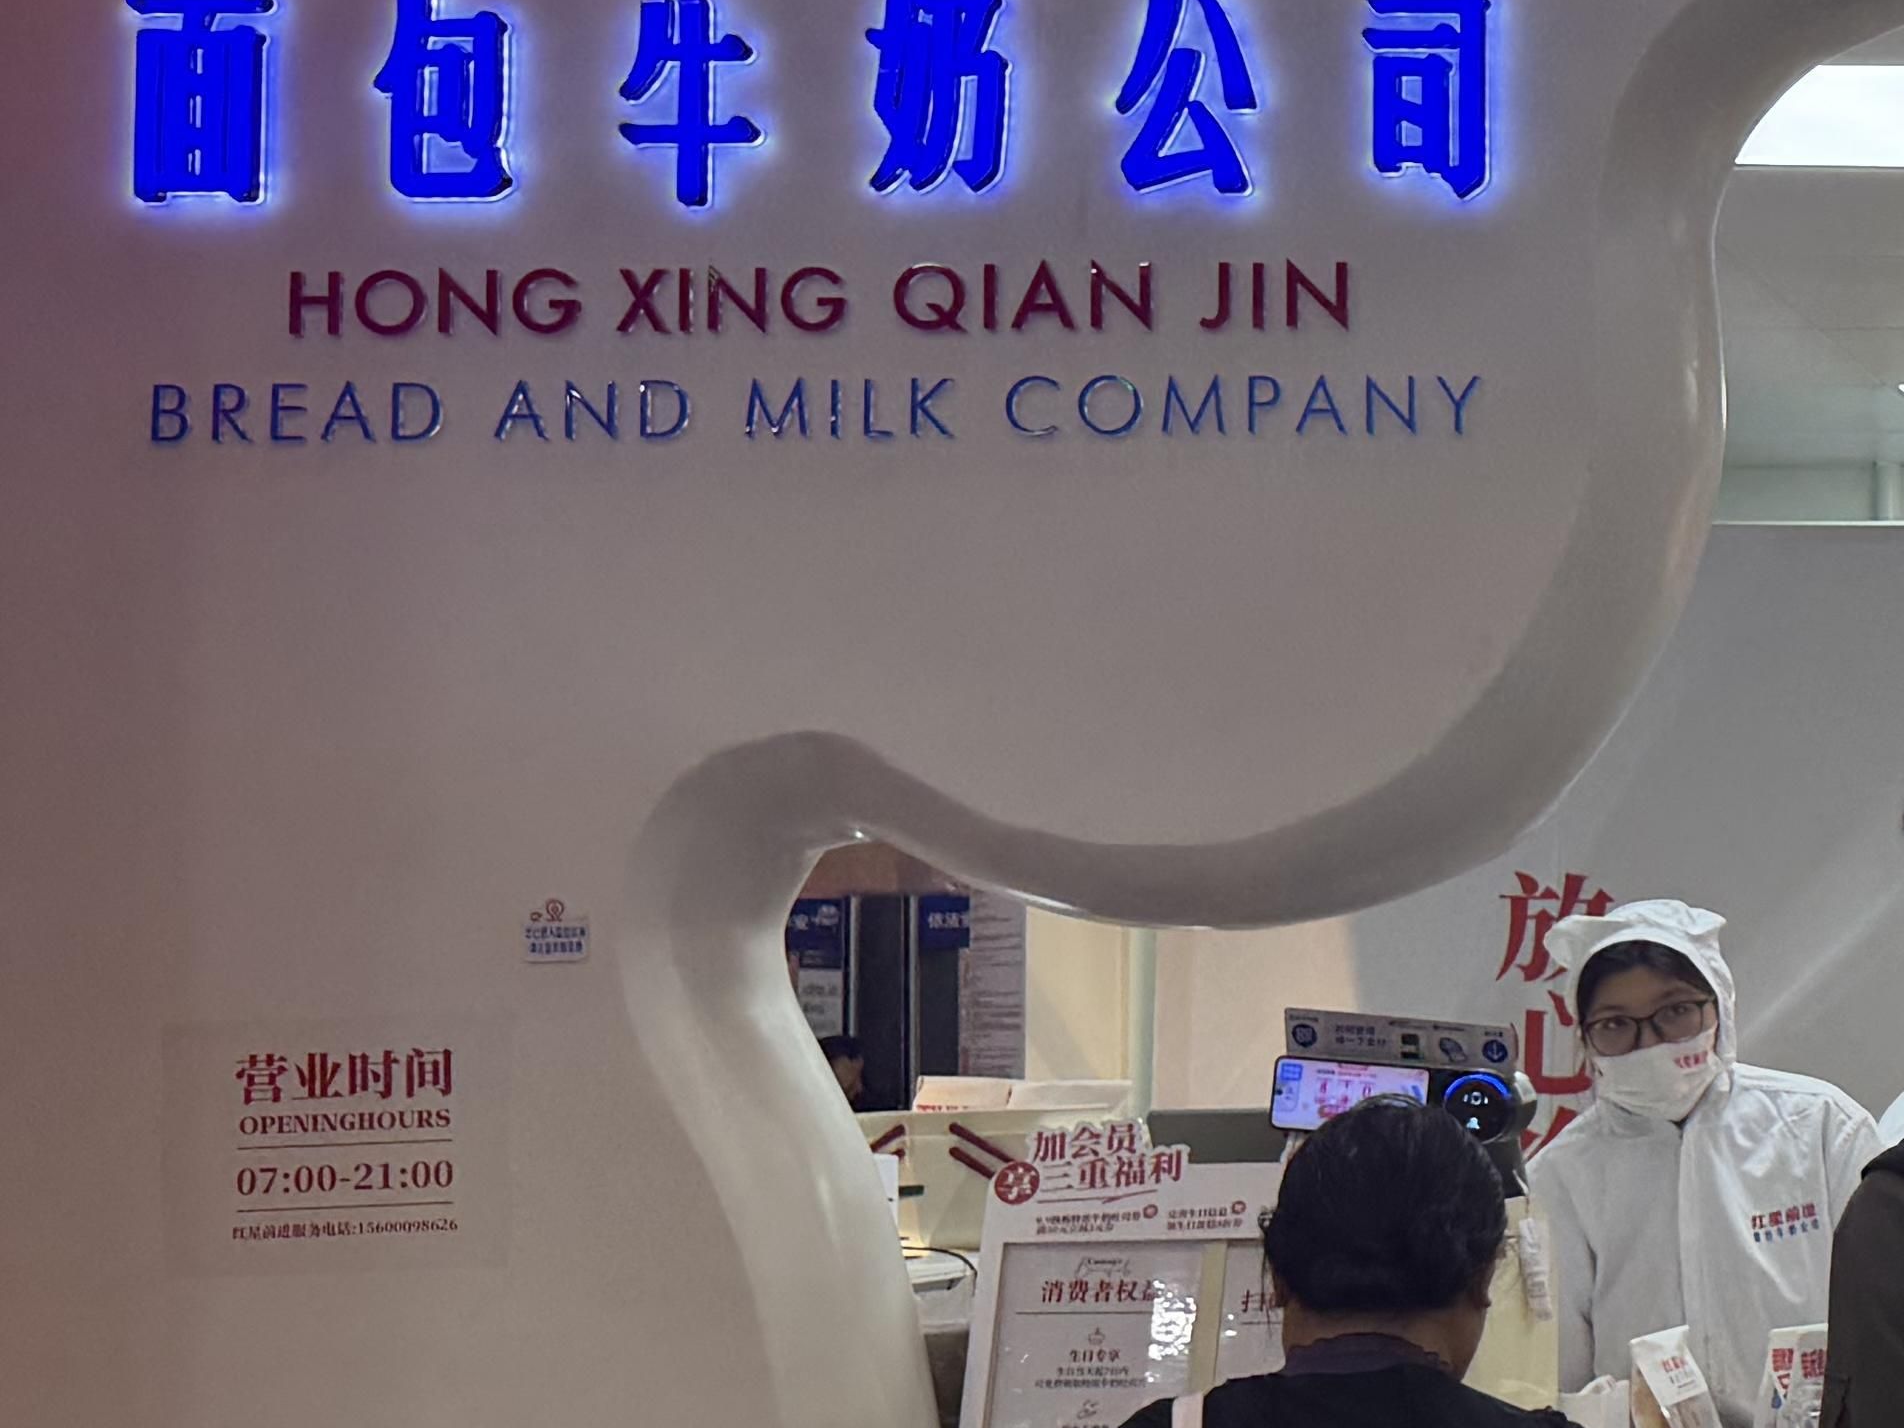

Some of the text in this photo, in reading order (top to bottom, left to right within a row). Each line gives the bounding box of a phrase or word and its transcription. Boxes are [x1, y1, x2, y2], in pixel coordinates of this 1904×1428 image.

[287, 259, 1352, 340] HONG XING QIAN JIN
[149, 372, 1482, 446] BREAD AND MILK COMPANY
[235, 1047, 453, 1106] 营业时间
[239, 1108, 451, 1136] OPENINGHOURS
[1034, 1124, 1137, 1163] 加会员
[237, 1160, 453, 1196] 07:00-21:00
[1041, 1149, 1182, 1193] 三重福利
